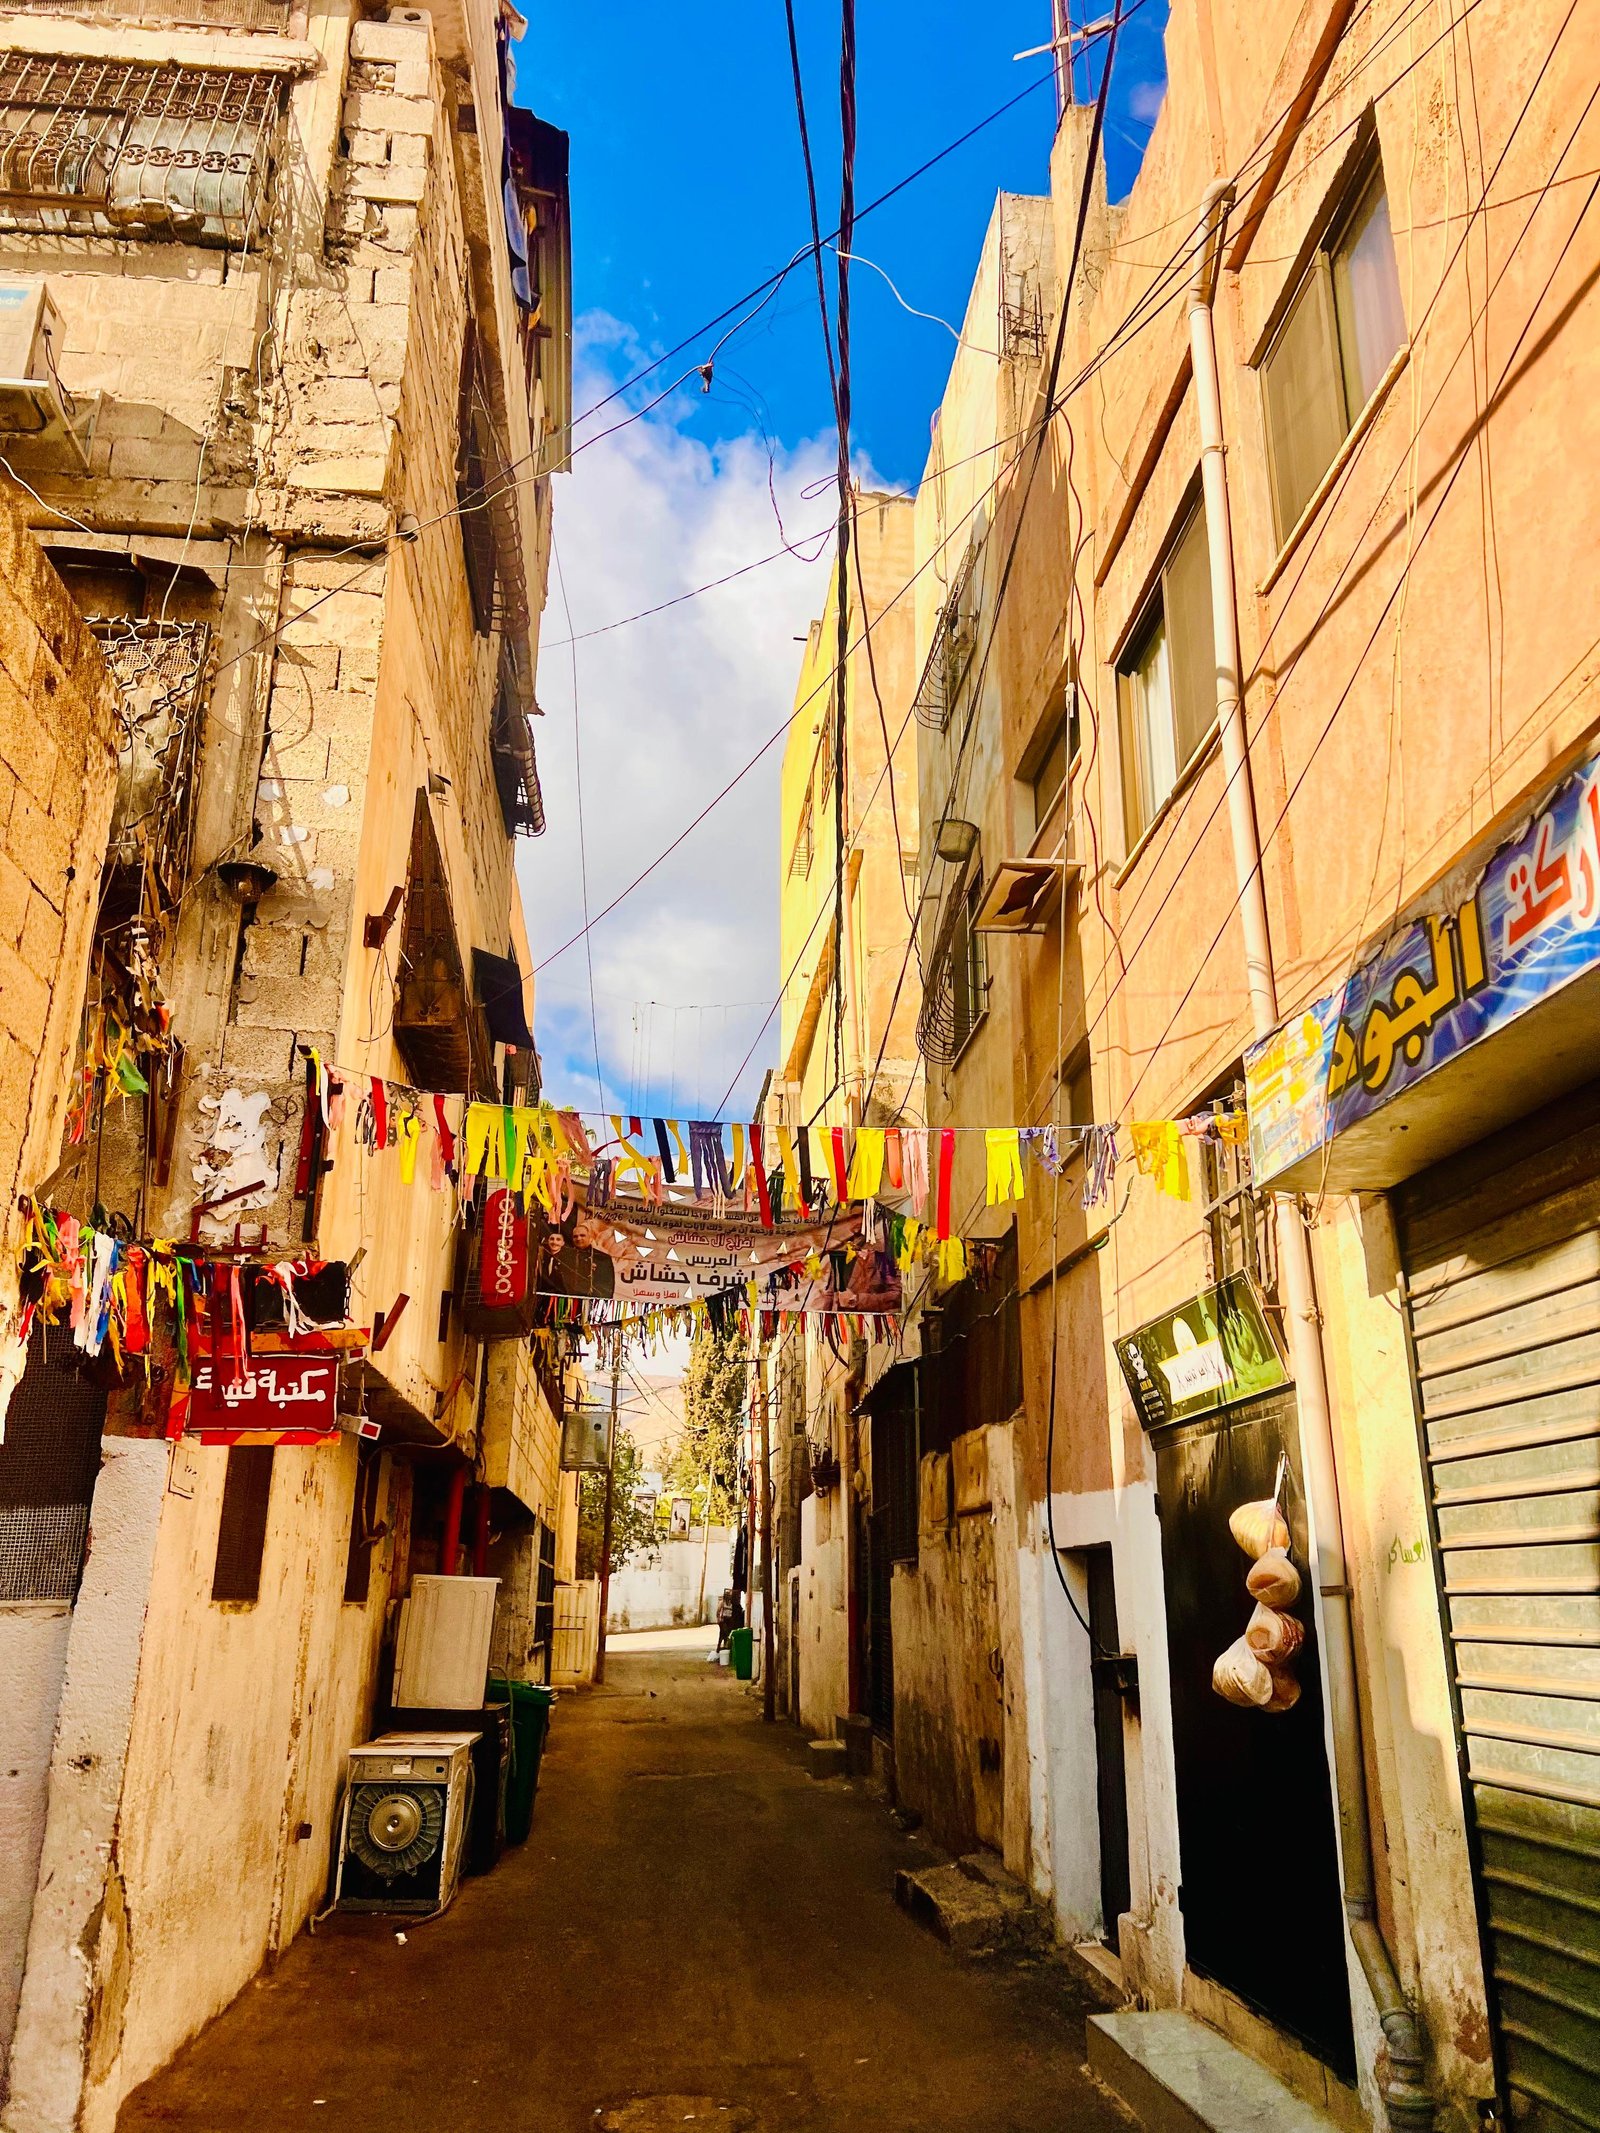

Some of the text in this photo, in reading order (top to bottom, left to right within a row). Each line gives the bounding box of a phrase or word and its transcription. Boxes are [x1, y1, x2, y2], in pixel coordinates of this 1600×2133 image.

[1504, 772, 1600, 952] اركت
[495, 1198, 518, 1294] ooredoo
[668, 1230, 710, 1246] حشاش
[620, 1262, 691, 1284] حشاش
[685, 1253, 738, 1269] العريس
[194, 1366, 330, 1409] مكتبة قتية
